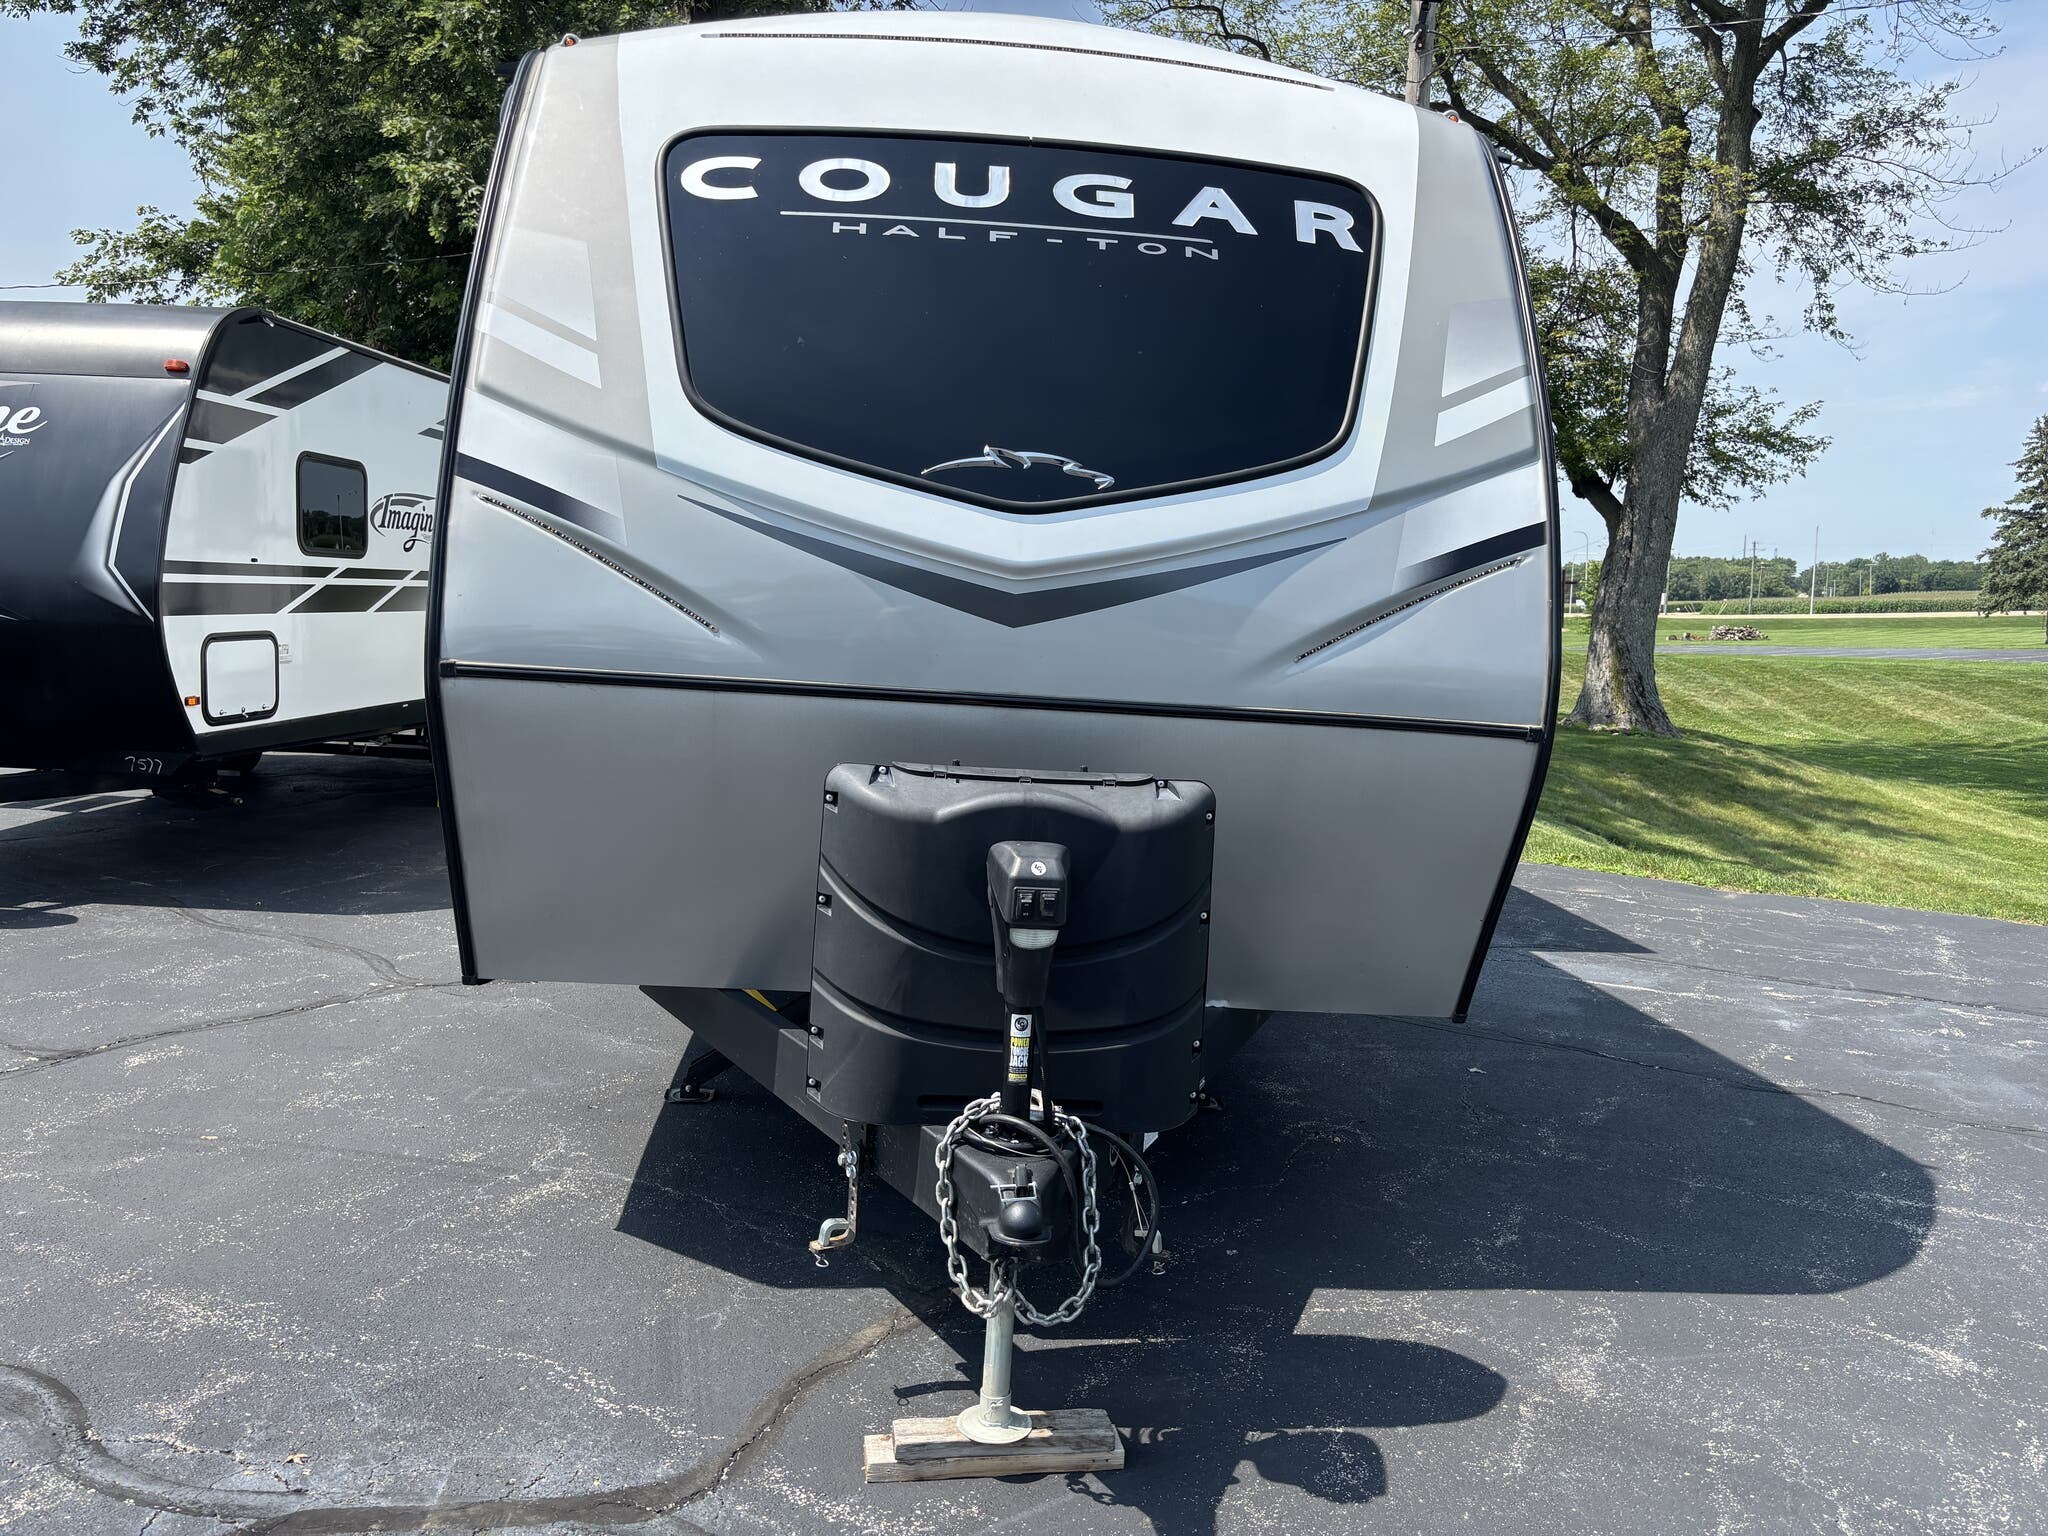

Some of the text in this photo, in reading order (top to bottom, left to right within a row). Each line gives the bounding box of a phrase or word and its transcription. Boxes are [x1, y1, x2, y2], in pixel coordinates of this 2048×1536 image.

[680, 156, 1364, 253] COUGAR
[832, 221, 1219, 261] HALF-TON
[378, 495, 434, 552] Imagin
[1009, 1054, 1029, 1067] JACK
